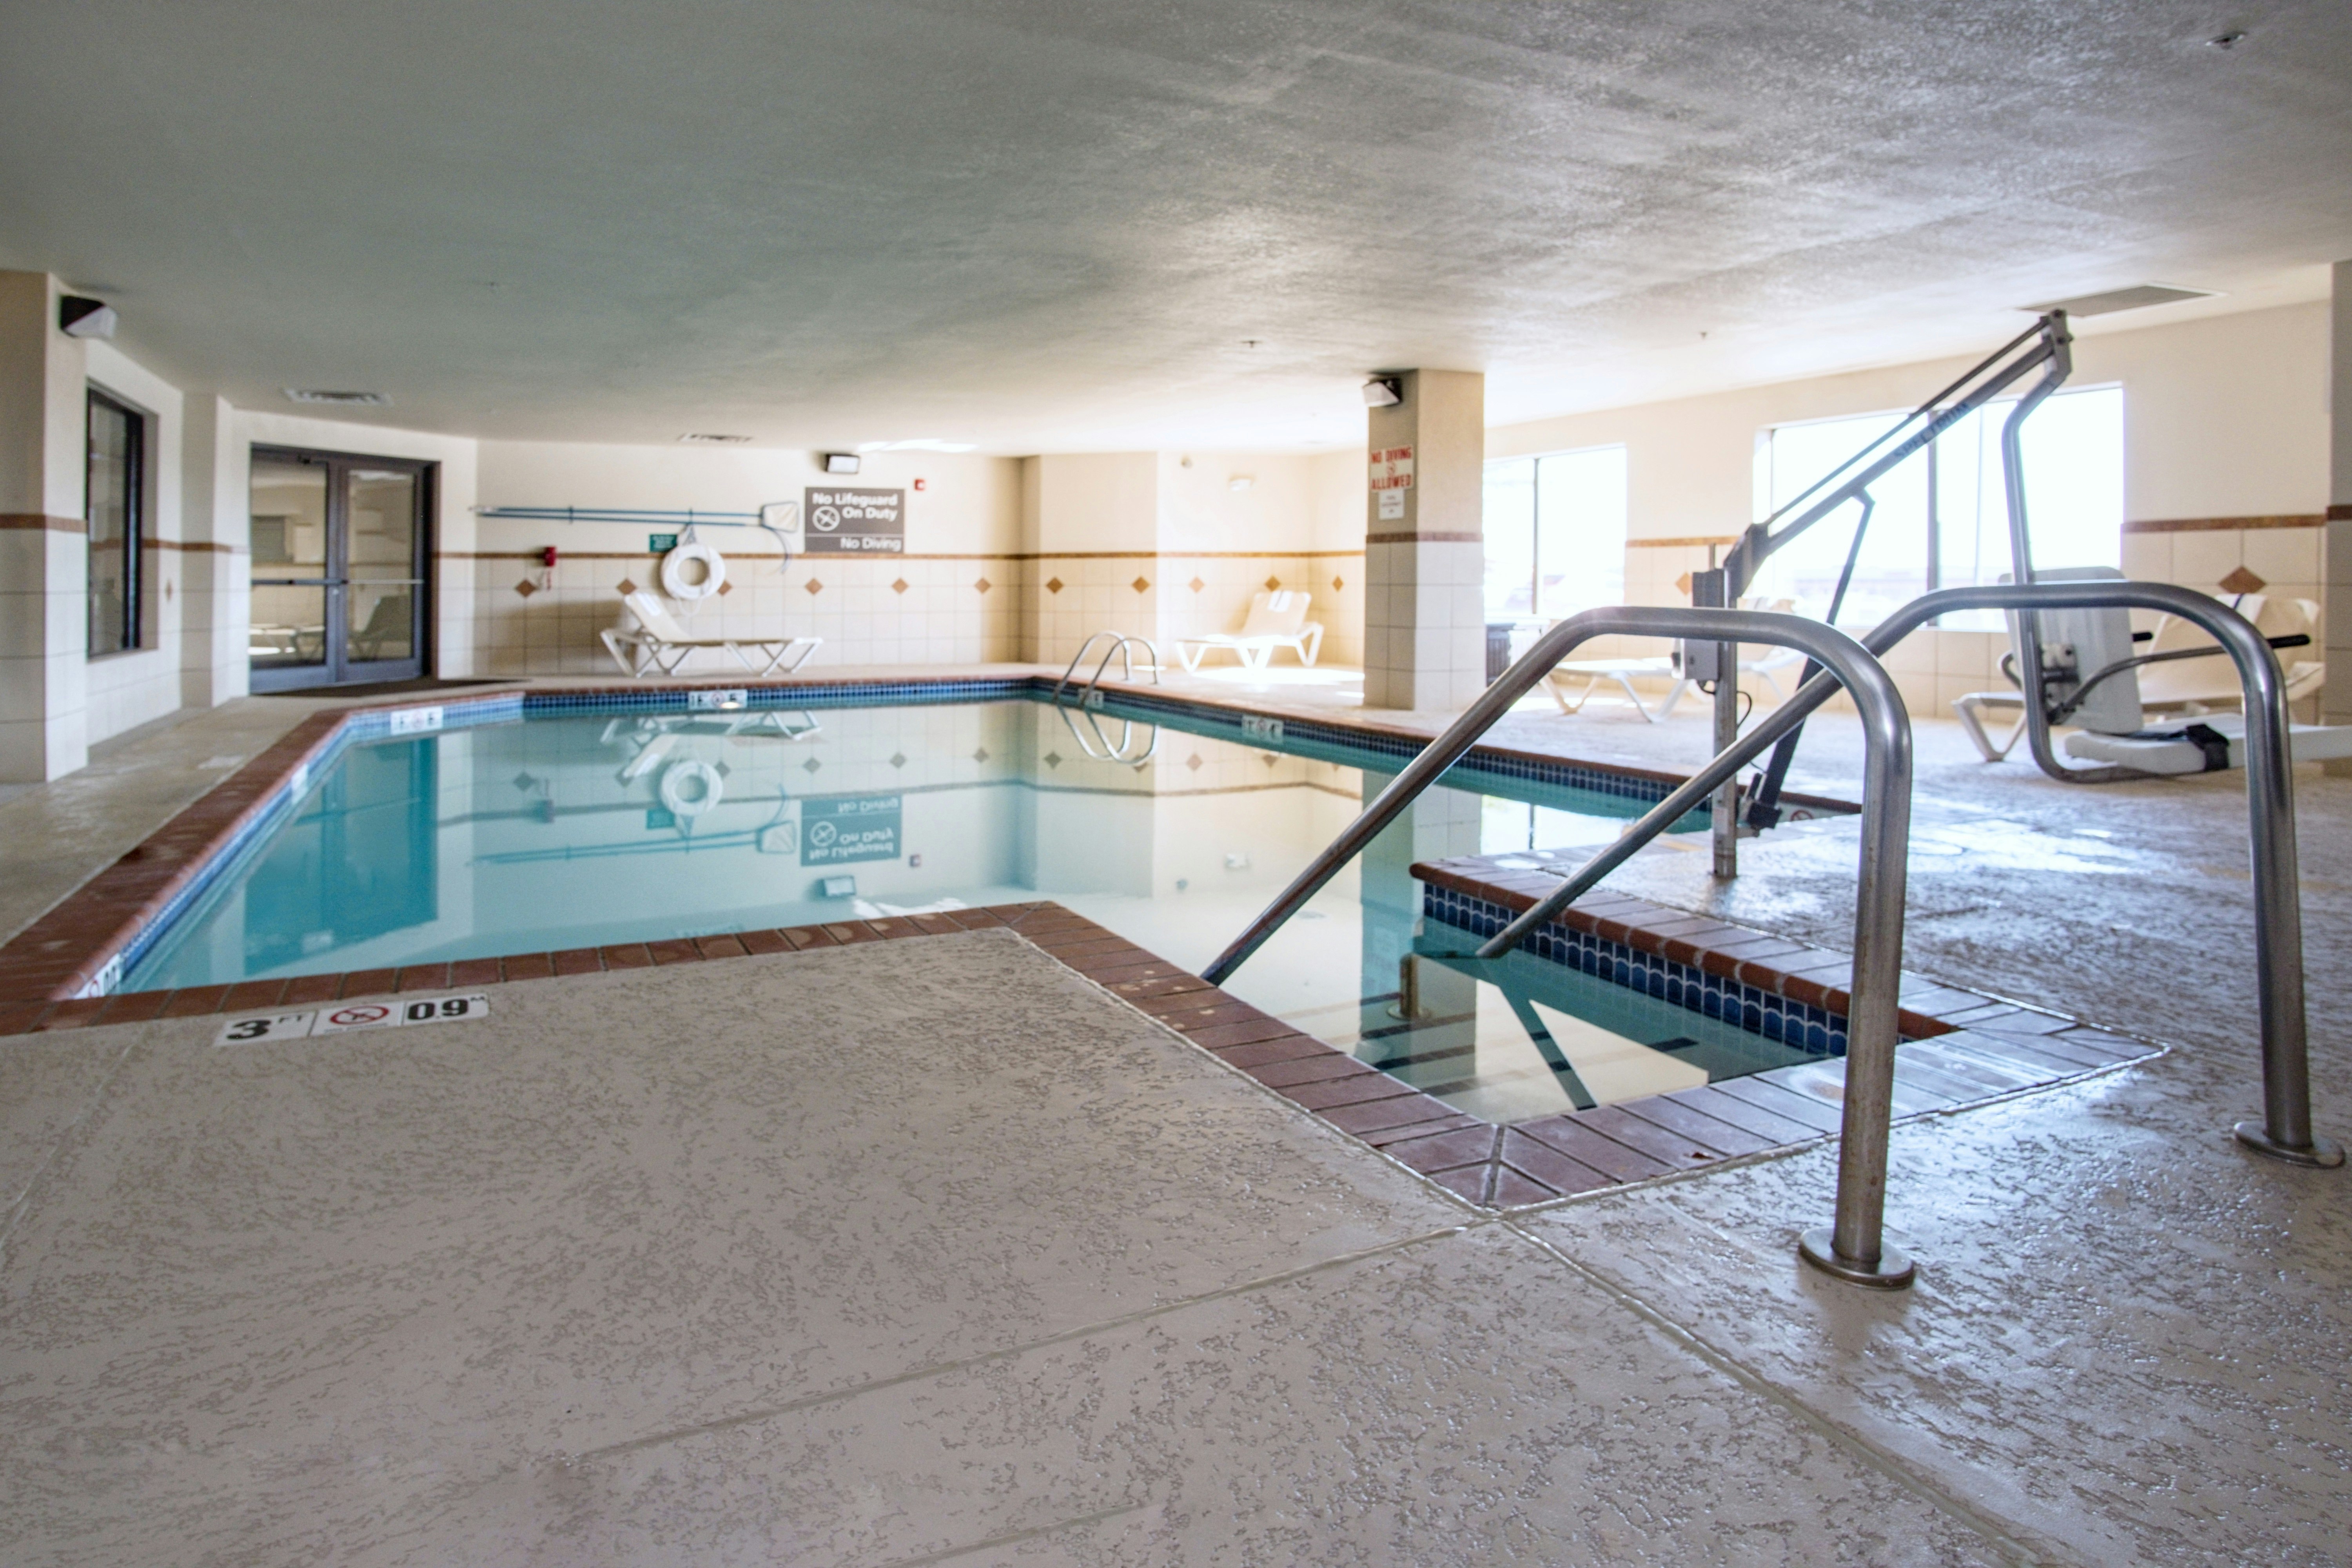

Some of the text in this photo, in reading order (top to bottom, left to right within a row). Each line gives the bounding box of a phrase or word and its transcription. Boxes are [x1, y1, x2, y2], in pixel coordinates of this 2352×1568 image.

[1372, 474, 1411, 490] ALLOWED
[812, 492, 898, 508] No Lifeguard
[842, 506, 898, 522] On Duty
[840, 537, 902, 552] No Diving
[227, 1020, 271, 1040] 3
